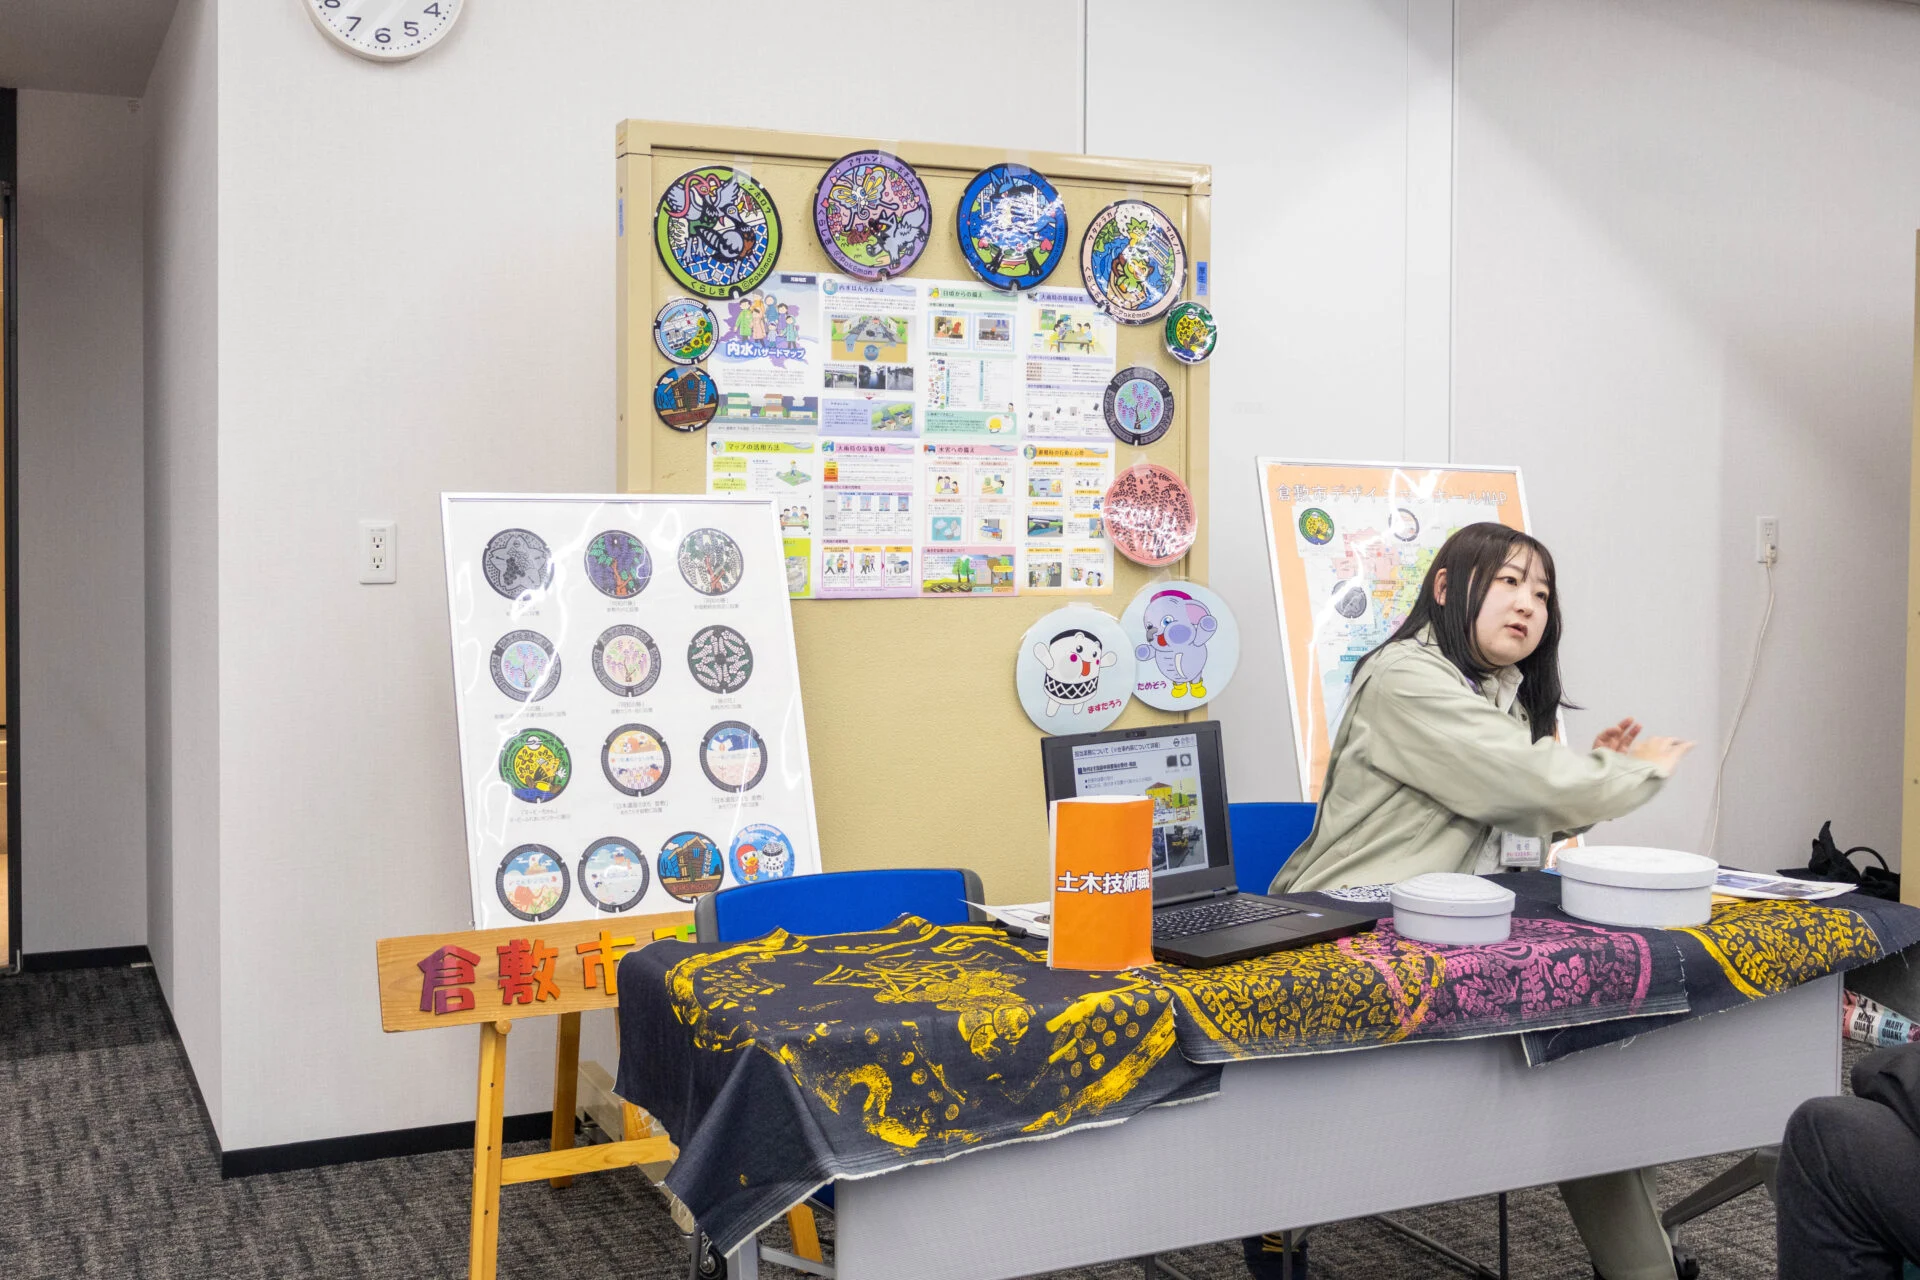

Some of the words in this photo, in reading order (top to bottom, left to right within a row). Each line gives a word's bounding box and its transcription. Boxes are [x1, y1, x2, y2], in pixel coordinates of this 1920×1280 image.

[423, 2, 441, 17] 4
[346, 16, 362, 32] 7
[403, 21, 419, 37] 5
[374, 28, 391, 43] 6
[690, 281, 726, 296] くらしき
[726, 341, 806, 360] 内水ハザードマップ
[1087, 699, 1122, 714] ますたろう
[1057, 869, 1150, 894] 土木技術職
[1857, 1011, 1875, 1024] MARY
[1885, 1019, 1904, 1031] MARY
[1853, 1020, 1874, 1034] QUANT
[1881, 1028, 1902, 1041] QUANT
